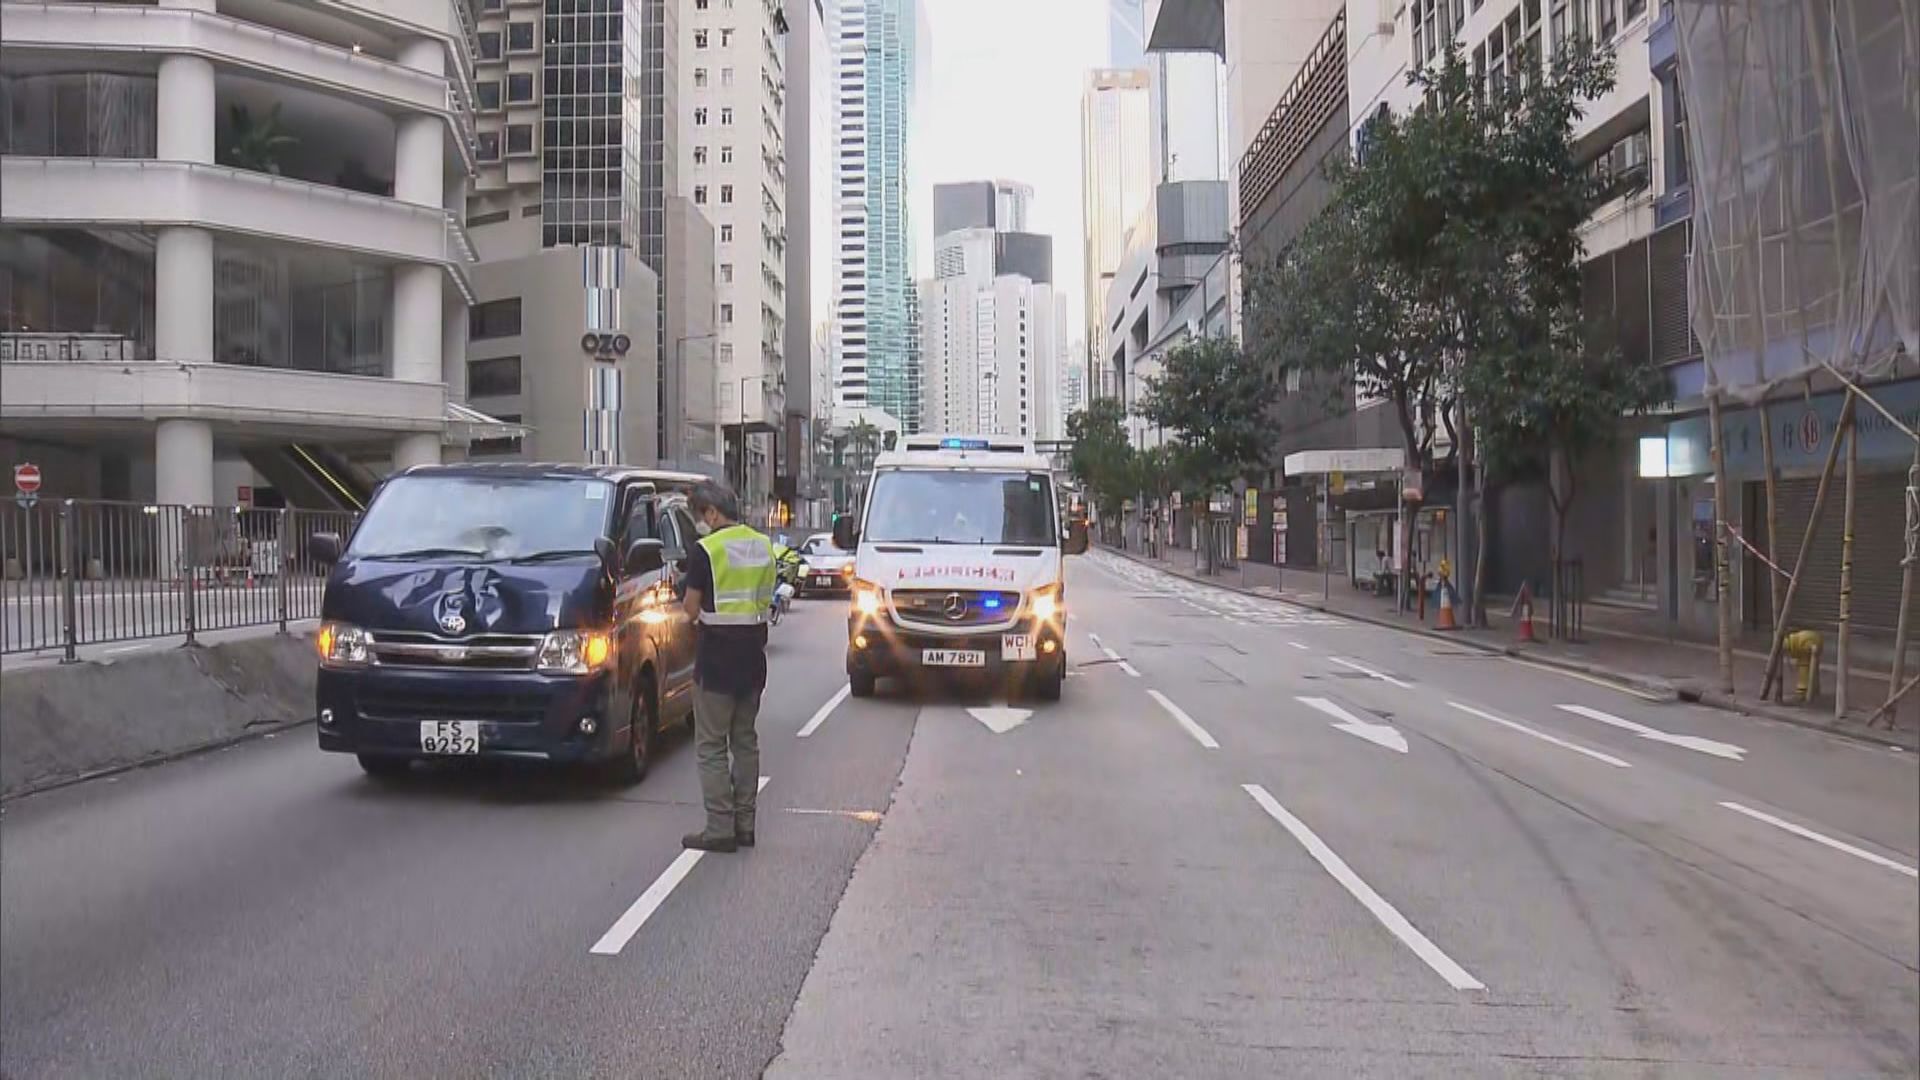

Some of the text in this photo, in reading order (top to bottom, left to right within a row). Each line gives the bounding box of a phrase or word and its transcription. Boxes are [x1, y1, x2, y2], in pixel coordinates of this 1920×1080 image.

[581, 333, 631, 354] OZO
[928, 651, 979, 663] AM 7821
[437, 721, 462, 737] FS
[424, 736, 476, 753] 8252
